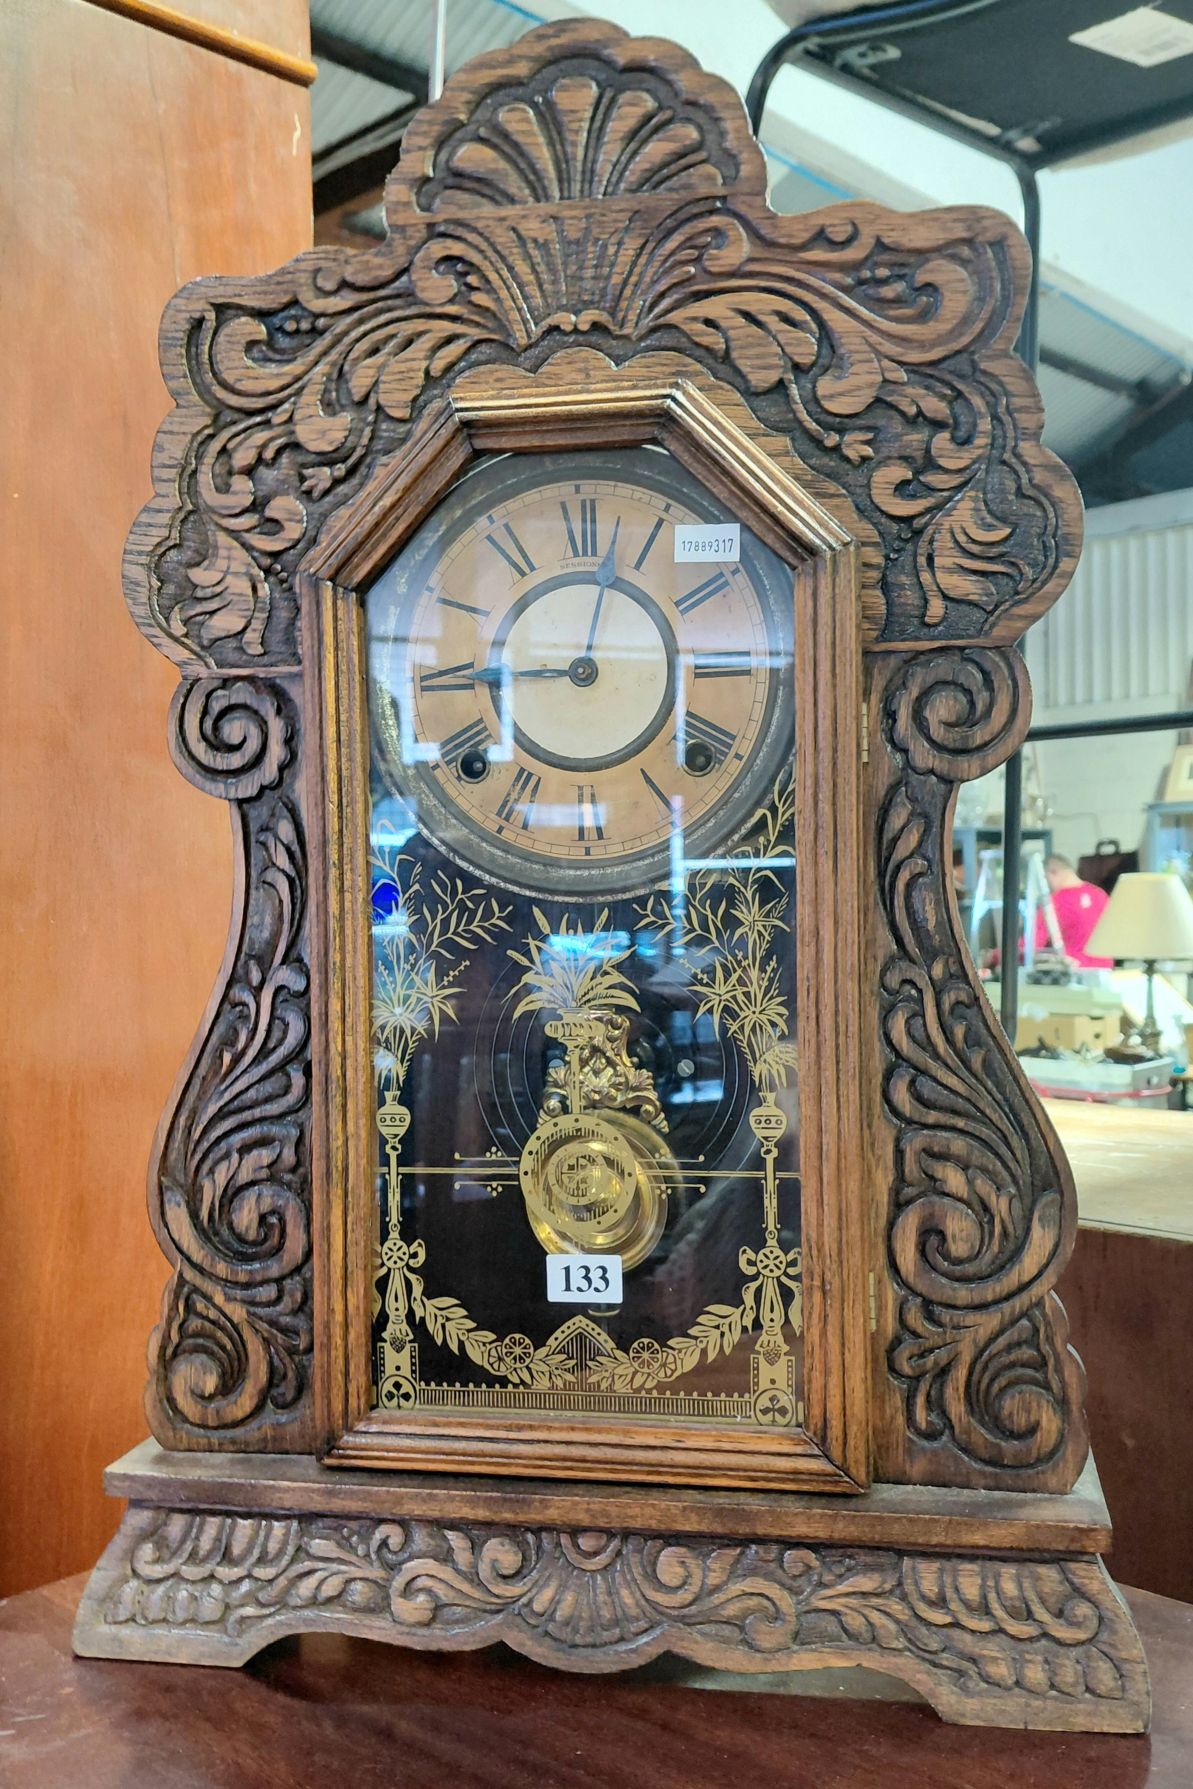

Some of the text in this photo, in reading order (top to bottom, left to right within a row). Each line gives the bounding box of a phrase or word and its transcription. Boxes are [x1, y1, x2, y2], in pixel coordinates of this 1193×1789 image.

[484, 520, 541, 589] XI
[627, 515, 669, 574] I
[681, 538, 734, 553] 17889317
[436, 584, 495, 630] X
[670, 569, 735, 622] II
[420, 656, 476, 696] IX
[571, 785, 611, 841] VI
[560, 1264, 610, 1293] 133
